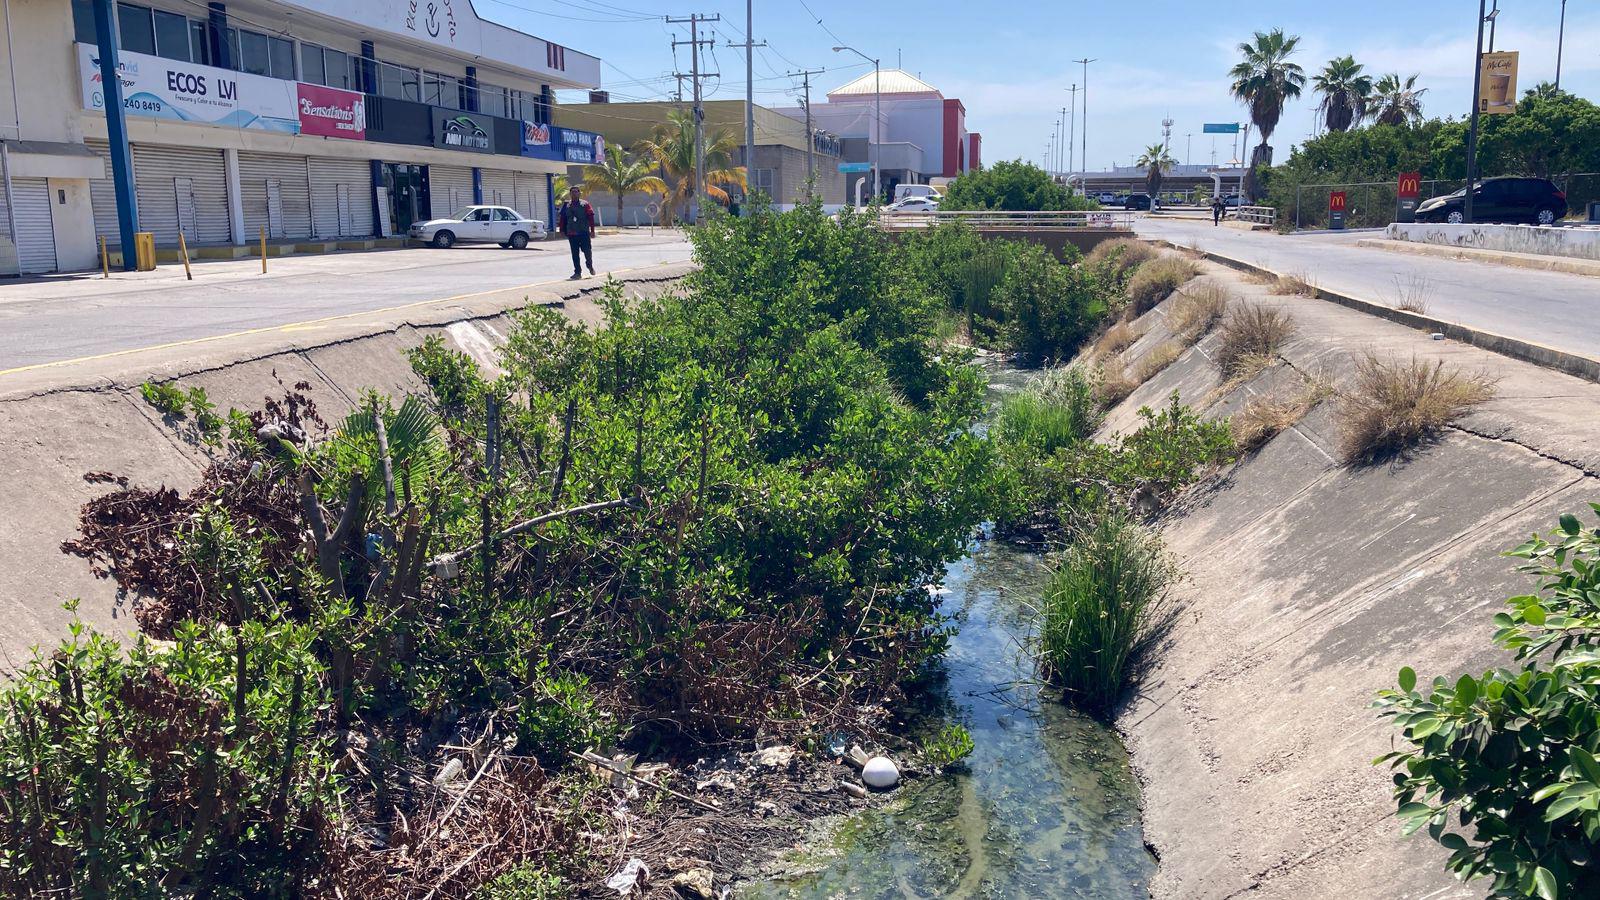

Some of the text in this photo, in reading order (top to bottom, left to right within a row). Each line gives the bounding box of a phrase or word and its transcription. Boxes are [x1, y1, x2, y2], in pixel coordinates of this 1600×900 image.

[407, 0, 417, 31] Pla
[444, 0, 456, 42] oria
[166, 70, 237, 101] ECOS LVI
[124, 99, 161, 112] 240 8419
[462, 135, 489, 149] MOTORS
[562, 131, 578, 144] TODO
[578, 133, 592, 147] PARA
[567, 148, 592, 161] PASTELES
